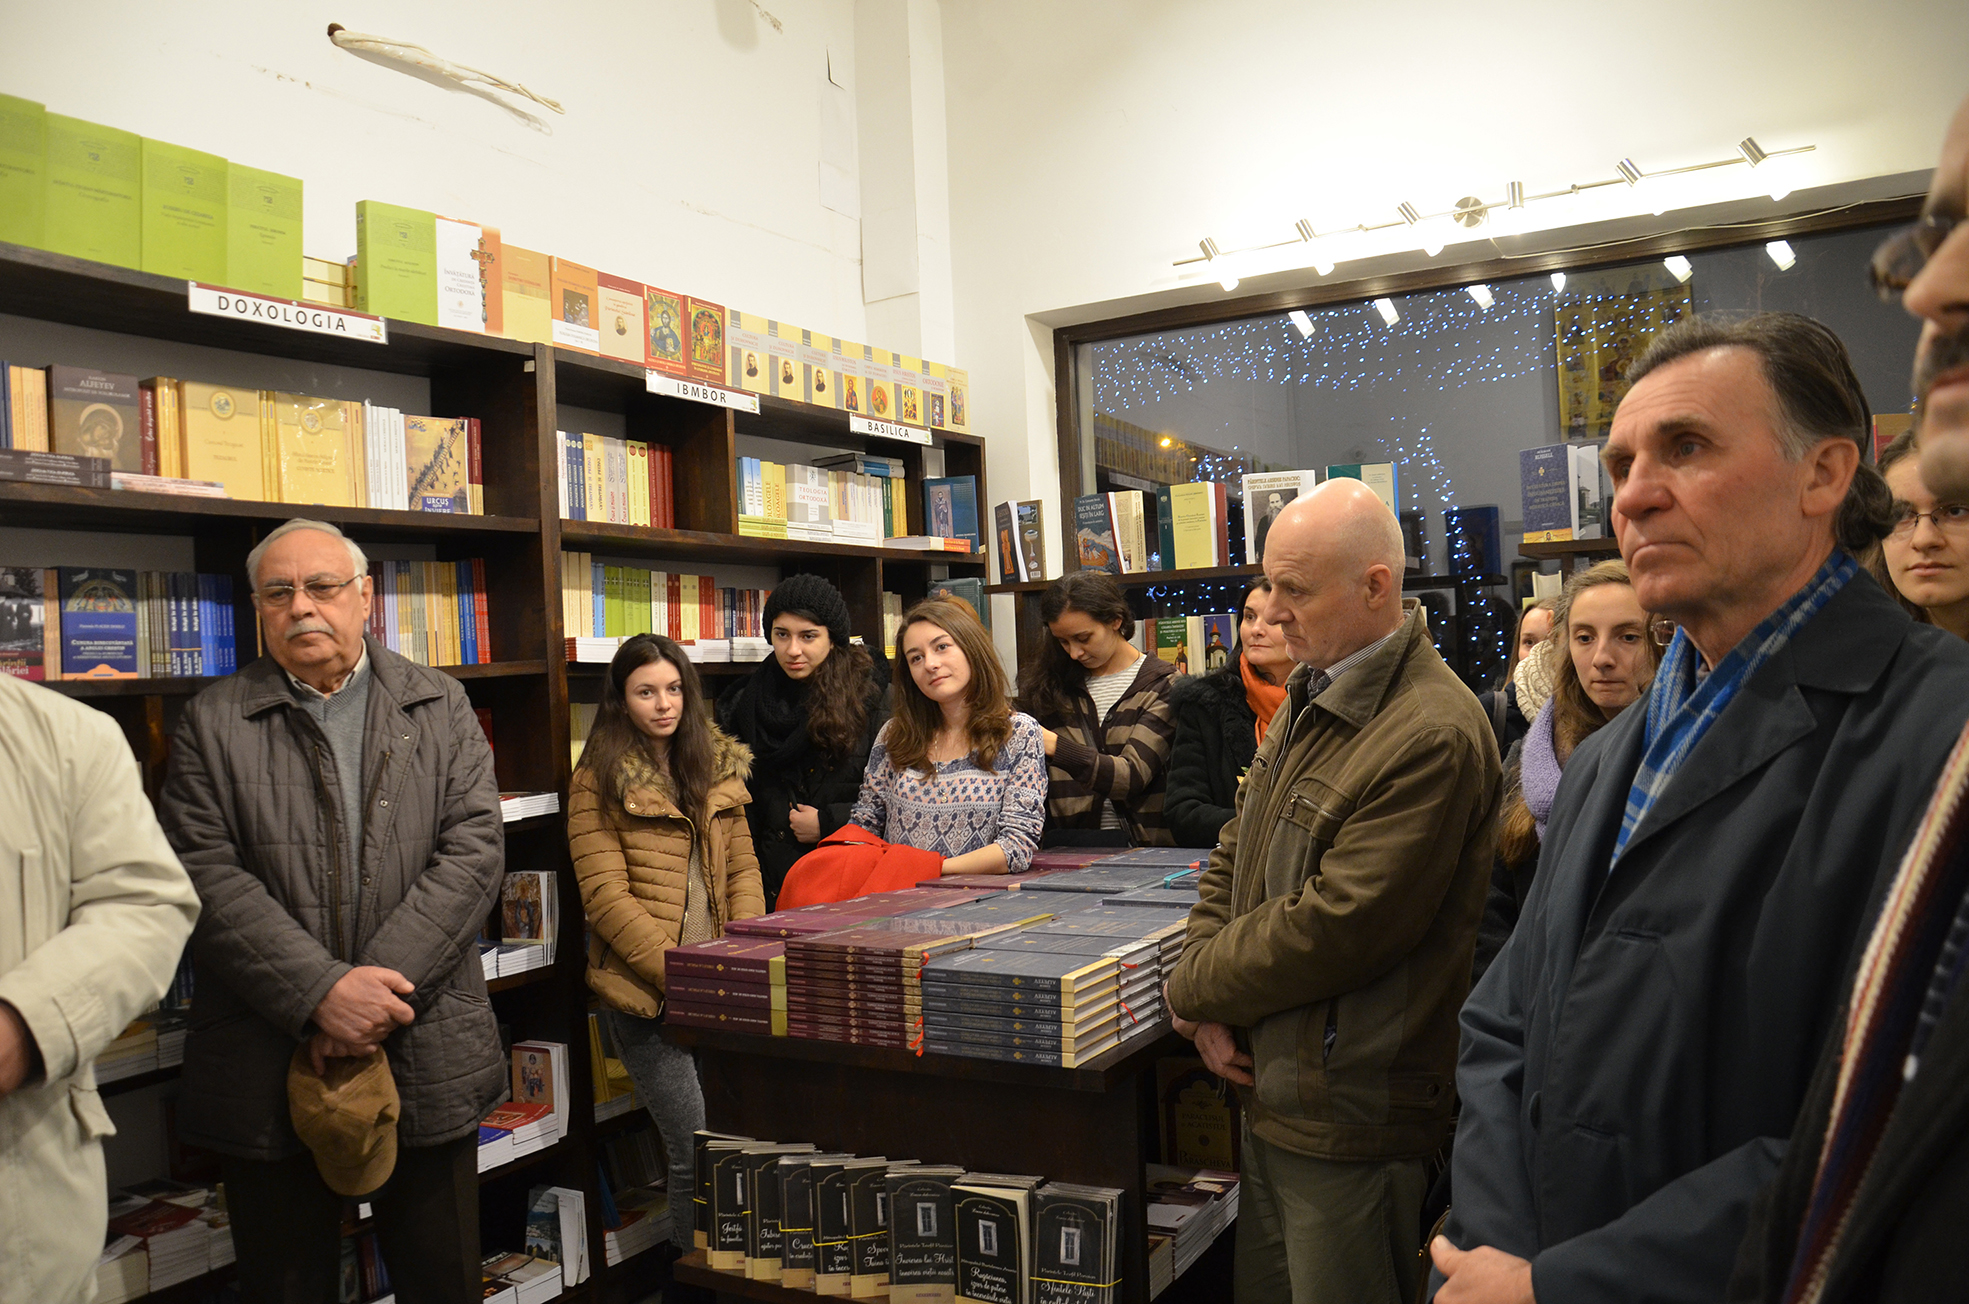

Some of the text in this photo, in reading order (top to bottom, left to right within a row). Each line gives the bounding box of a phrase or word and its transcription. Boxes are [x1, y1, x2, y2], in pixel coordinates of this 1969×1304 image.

[217, 295, 347, 332] DOXOLOGIA
[79, 379, 115, 390] ALFEYEV
[677, 382, 727, 404] IBMBOR
[867, 421, 910, 438] BASILICA
[798, 486, 828, 496] TEOLOGIA
[426, 497, 449, 507] URCUȘ
[798, 494, 828, 503] ORTODOXĂ
[1077, 505, 1086, 513] DUC
[1090, 503, 1105, 511] ALTUM
[1179, 1150, 1232, 1169] PARASCHEVA
